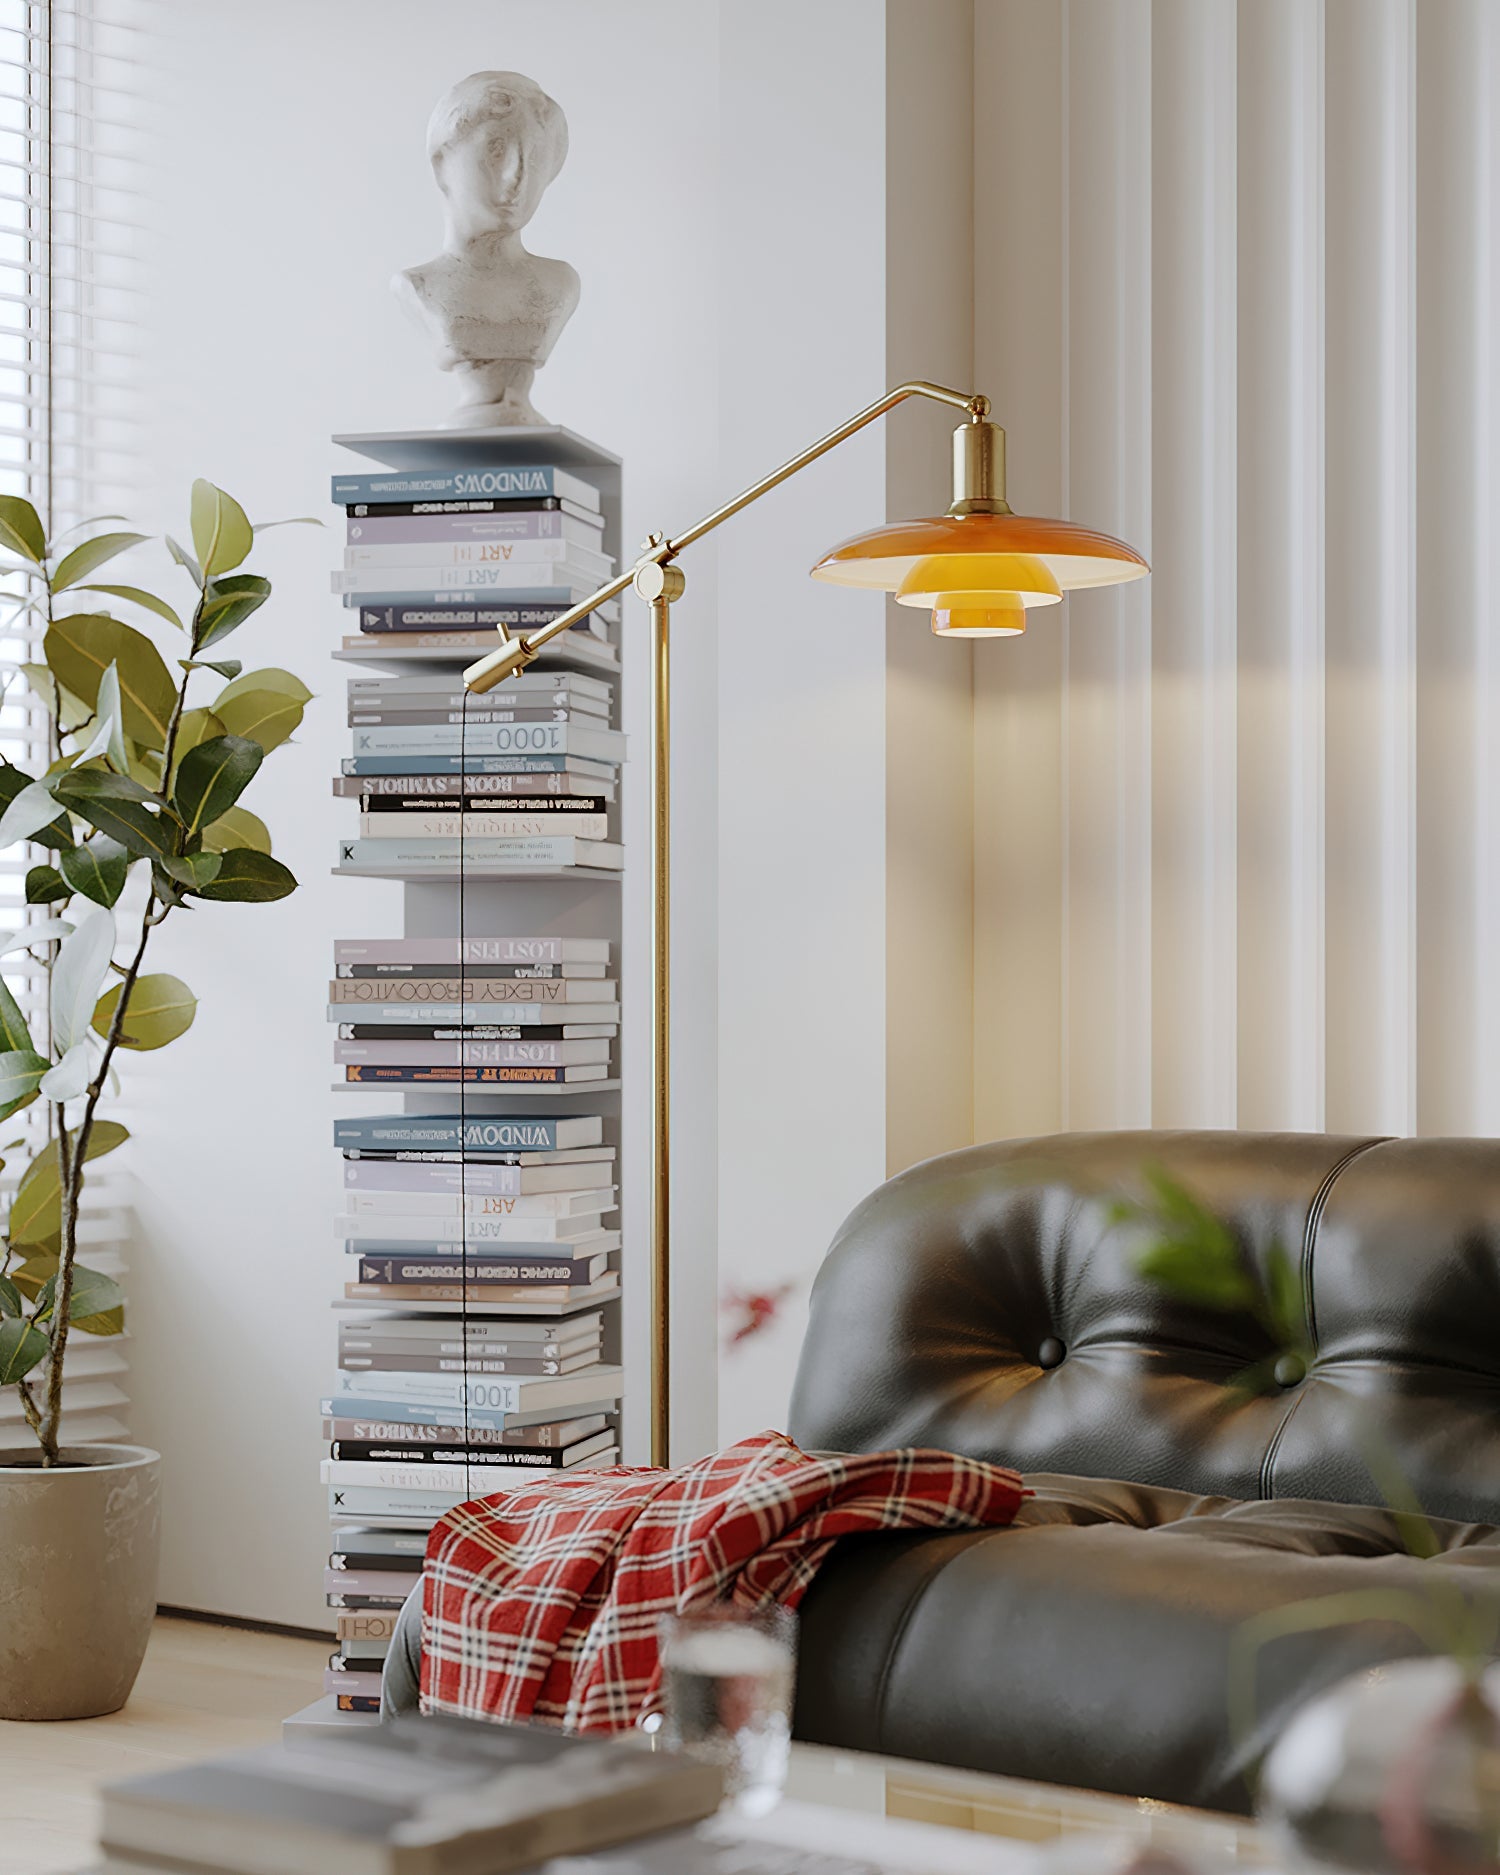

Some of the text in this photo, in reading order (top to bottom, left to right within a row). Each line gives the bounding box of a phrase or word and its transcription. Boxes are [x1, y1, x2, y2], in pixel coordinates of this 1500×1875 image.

[455, 472, 547, 494] WINDOWS
[480, 545, 513, 561] ART
[465, 569, 499, 584] ART
[497, 728, 559, 750] 1000
[363, 777, 447, 794] SYMBOLS
[463, 776, 512, 793] BOOK
[504, 941, 555, 959] LOST
[481, 983, 560, 1000] ALEXEY
[504, 1044, 555, 1062] LOST
[457, 1126, 550, 1146] WINDOWS
[482, 1198, 516, 1214] ART
[468, 1222, 502, 1238] ART
[459, 1385, 512, 1408] 1000
[354, 1424, 437, 1440] SYMBOLS
[454, 1427, 503, 1443] BOOK
